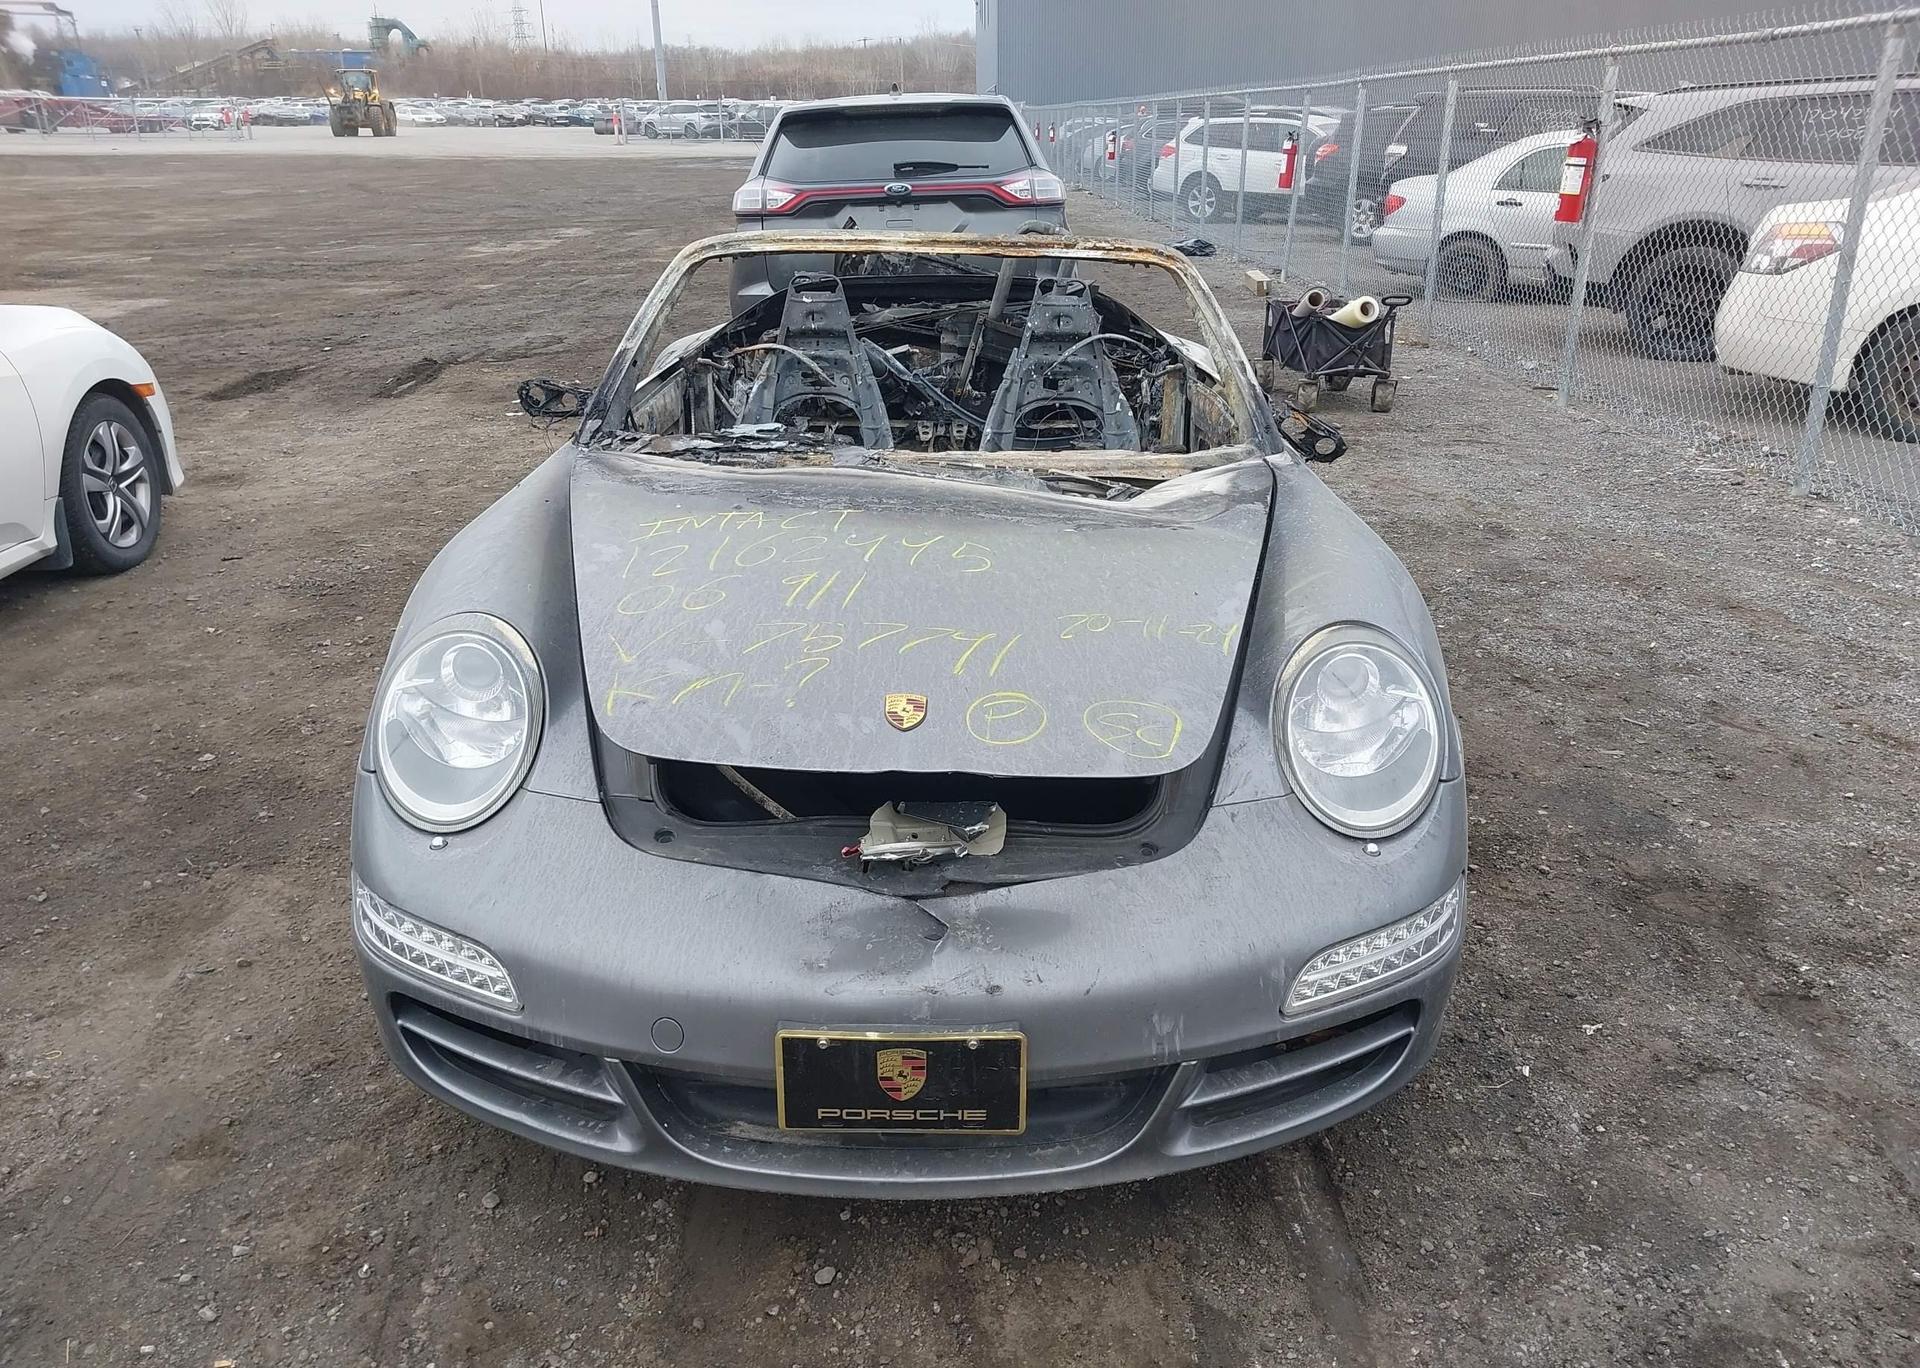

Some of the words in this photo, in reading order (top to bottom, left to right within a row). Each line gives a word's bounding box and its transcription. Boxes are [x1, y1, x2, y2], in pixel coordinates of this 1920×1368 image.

[628, 509, 865, 543] INTACT
[622, 532, 992, 578] 12162445
[617, 574, 743, 615] 06
[782, 570, 868, 610] 911
[817, 1108, 988, 1121] PORSCHE
